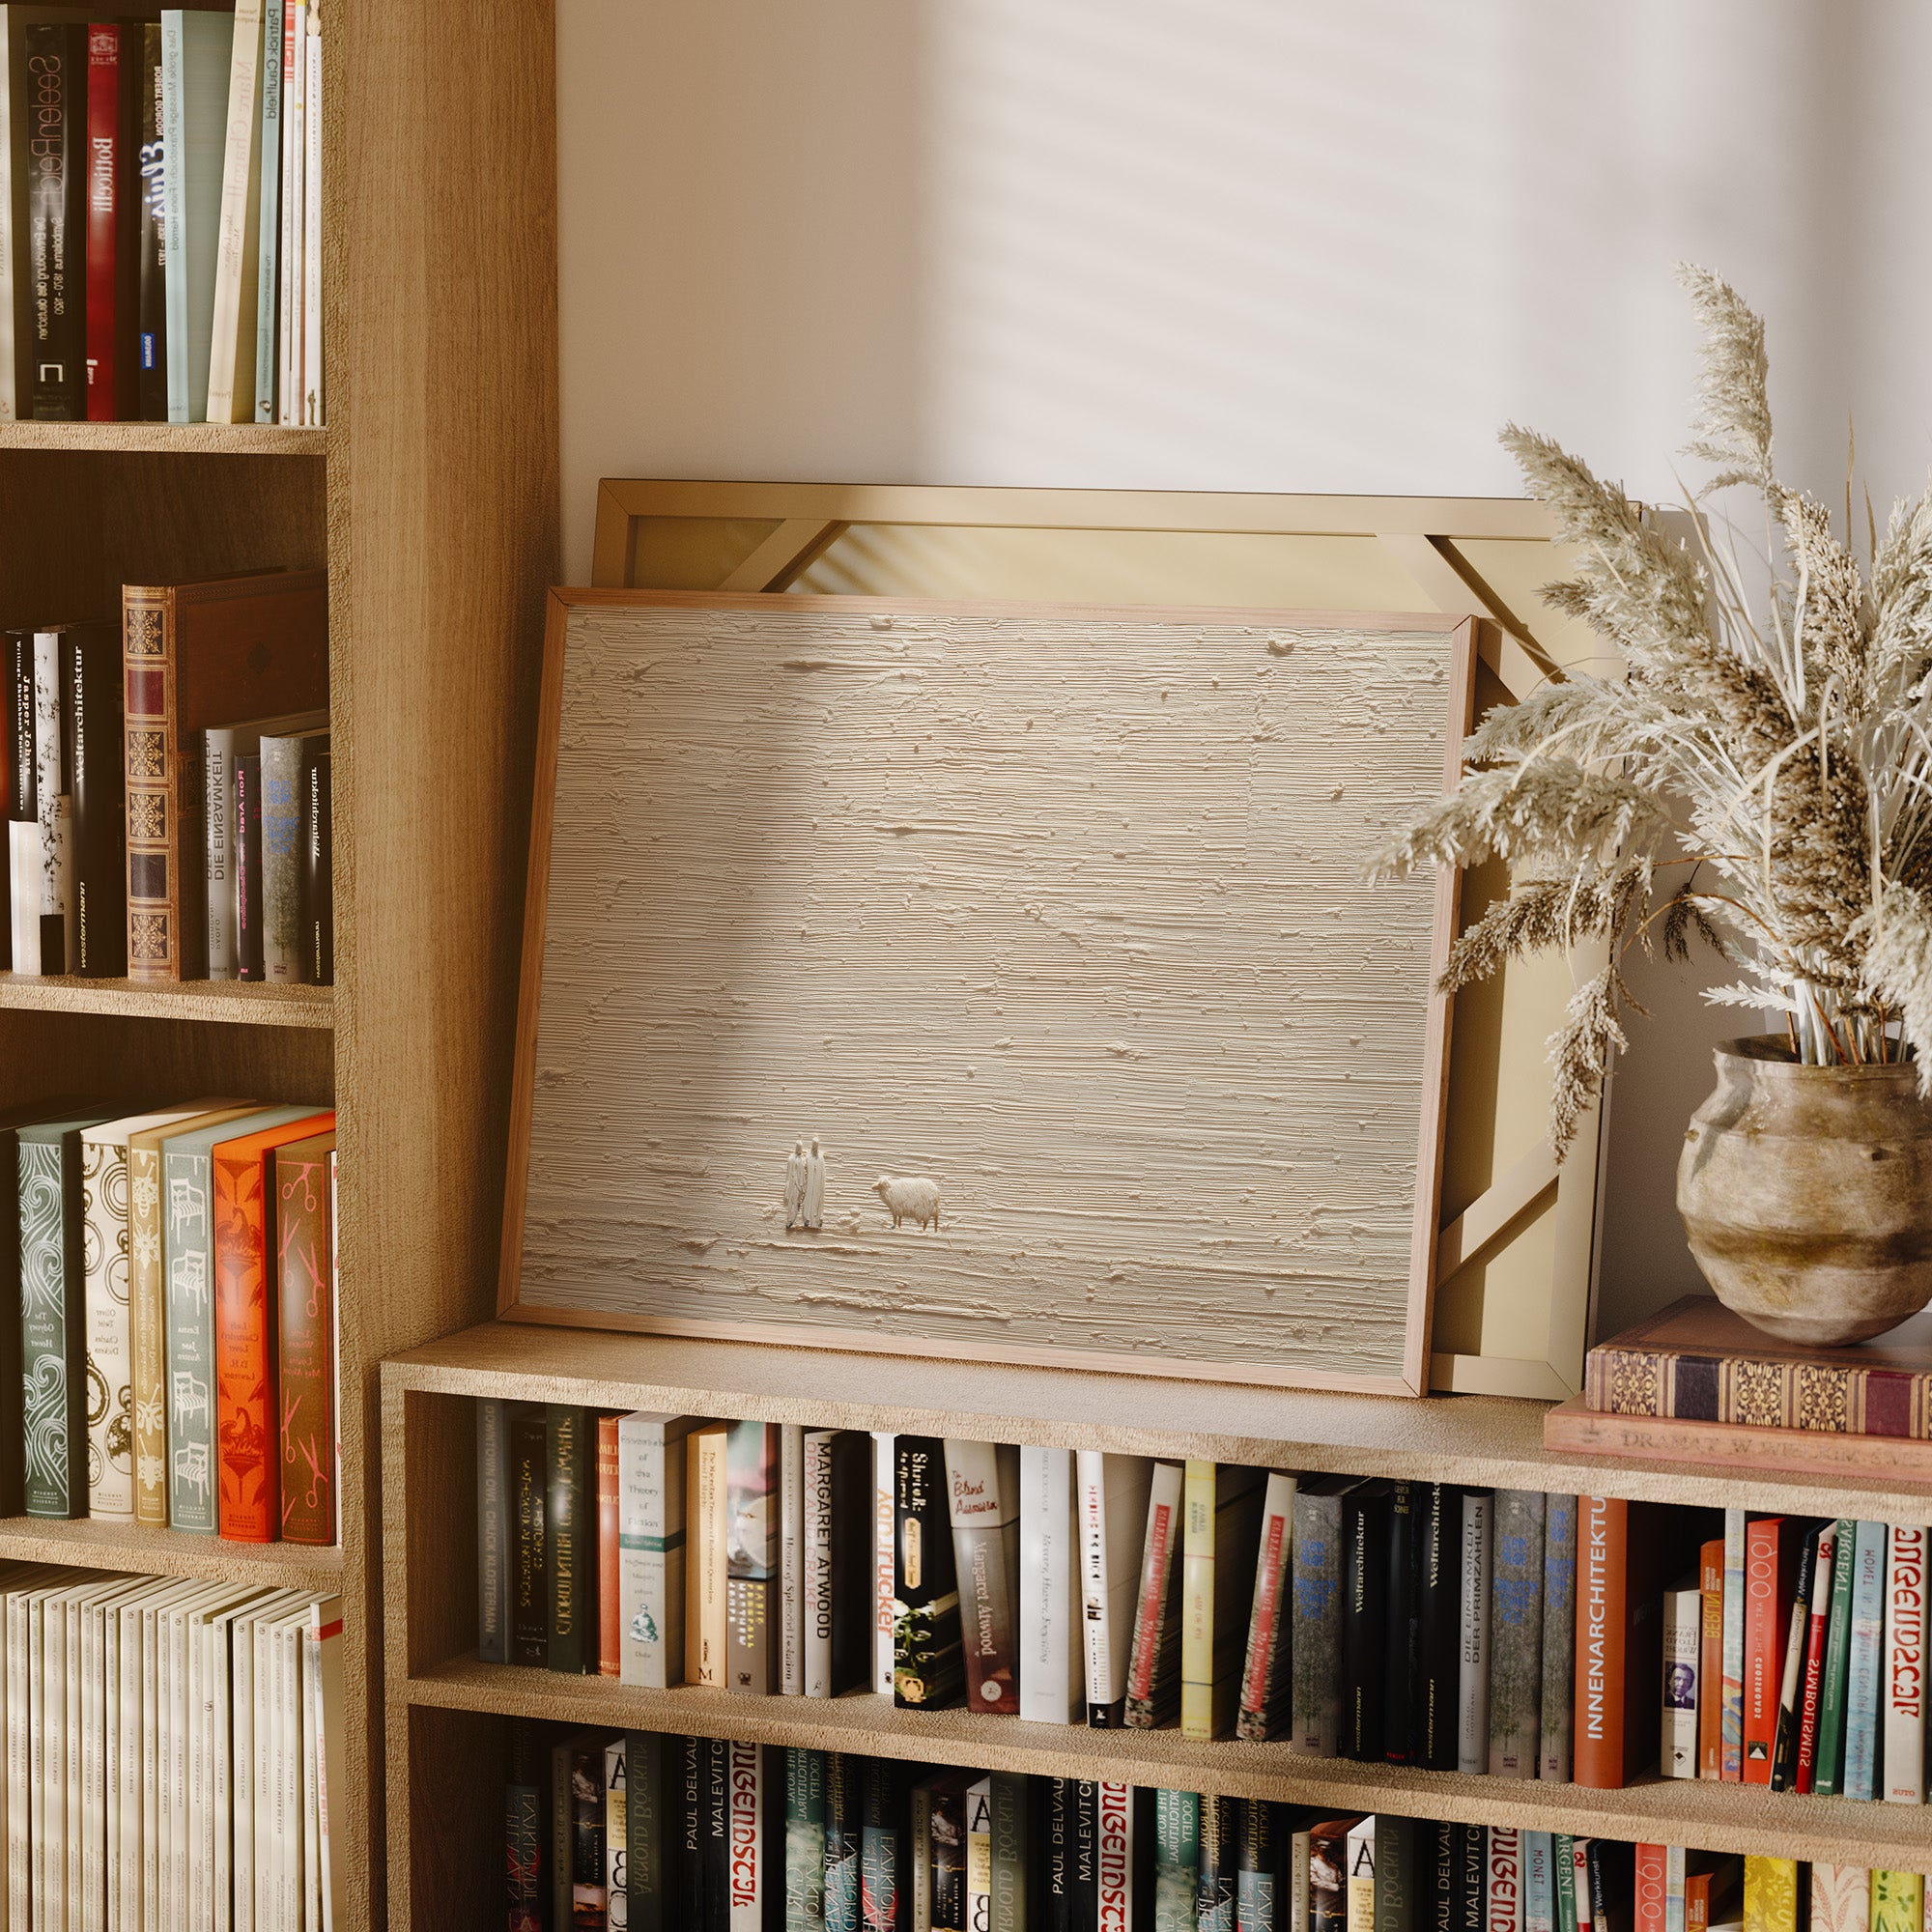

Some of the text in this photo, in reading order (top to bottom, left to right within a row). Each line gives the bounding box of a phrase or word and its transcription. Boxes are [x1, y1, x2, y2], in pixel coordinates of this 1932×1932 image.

[74, 645, 85, 782] Weltarchitektur
[484, 1406, 497, 1634] DOWNTOWN OWL CHUCK KLOSTERMAN
[628, 1518, 658, 1528] Fiction
[629, 1485, 659, 1497] Theory
[636, 1469, 650, 1479] the
[953, 1480, 984, 1496] Blind
[783, 1572, 794, 1583] of
[805, 1441, 816, 1613] ORYX AND CRAKE
[816, 1441, 830, 1640] MARGARET ATWOOD
[1354, 1511, 1366, 1614] Weltarchitektur
[1430, 1482, 1441, 1588] Weltarchitek
[1464, 1521, 1473, 1629] EINSAMKEIT
[971, 1541, 996, 1656] Margaret Atwood
[1472, 1505, 1483, 1663] DER PRIMZAHLEN
[1587, 1495, 1606, 1740] INNENARCHITEKTU
[1354, 1686, 1363, 1751] westermann
[1426, 1677, 1435, 1760] westermann
[686, 1738, 697, 1850] PAUL DELVAU
[1052, 1777, 1064, 1894] PAUL DELVAU
[1438, 1821, 1450, 1889] DELVAU
[1533, 1849, 1545, 1885] MONET
[1593, 1861, 1604, 1908] Werkkunst
[1636, 1856, 1662, 1918] 1900
